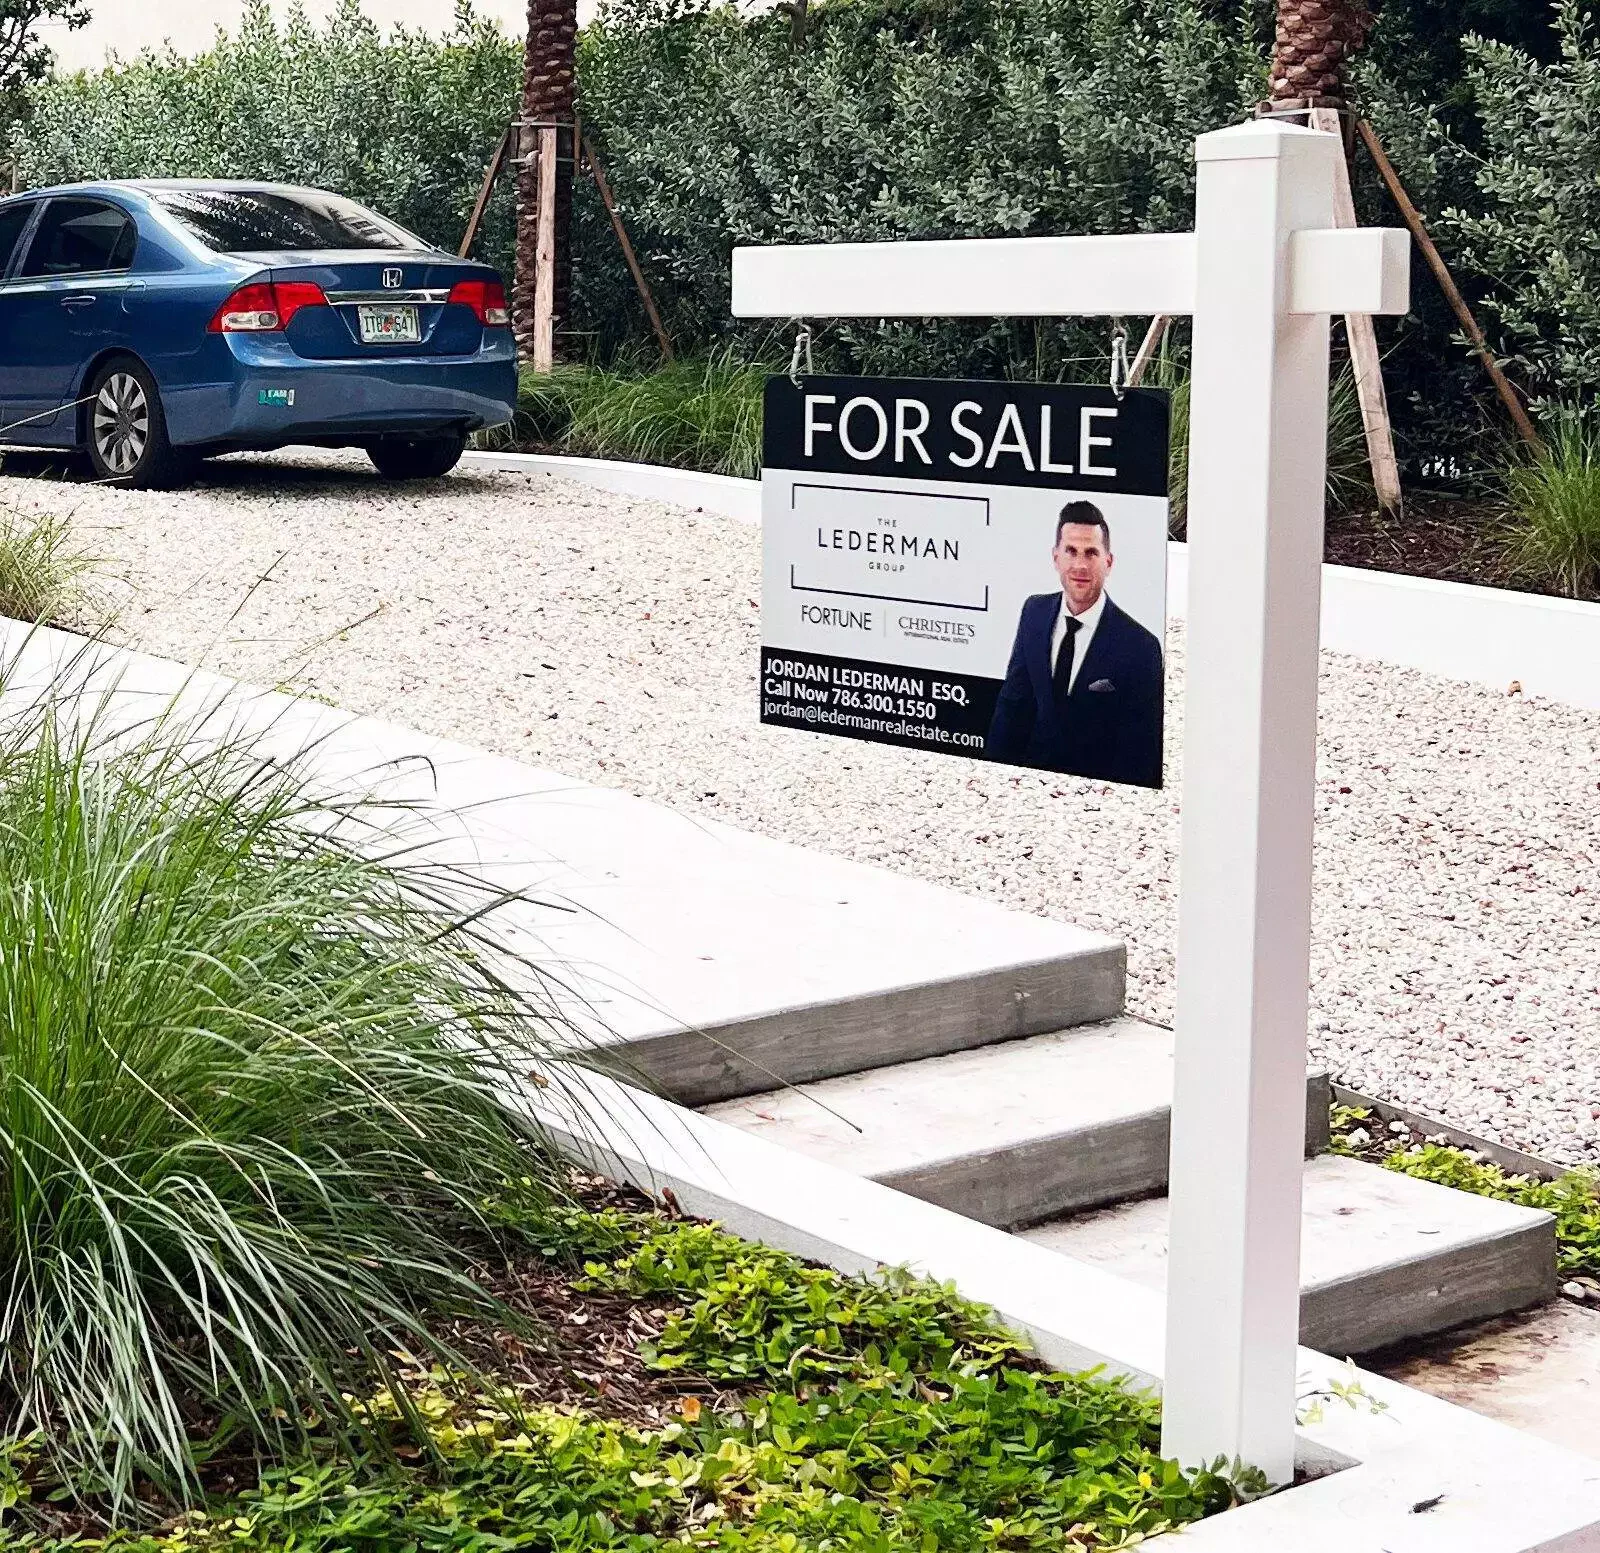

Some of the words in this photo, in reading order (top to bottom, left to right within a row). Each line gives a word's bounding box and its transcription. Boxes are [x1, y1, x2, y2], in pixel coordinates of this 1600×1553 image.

[803, 394, 932, 465] FOR
[948, 400, 1119, 478] SALE
[877, 518, 897, 528] THE
[818, 528, 960, 561] LEDERMAN
[868, 561, 905, 572] GROUP
[801, 604, 872, 631] FORTUNE
[898, 616, 976, 638] CHRISTIE'S
[764, 678, 791, 697] Call
[794, 682, 829, 703] Now
[831, 687, 937, 720] 786.300.1550
[765, 658, 829, 683] JORDAN
[833, 667, 924, 697] LEDERMAN
[931, 681, 970, 706] ESQ.
[763, 698, 985, 749] jordan@ledermanrealestate.com
